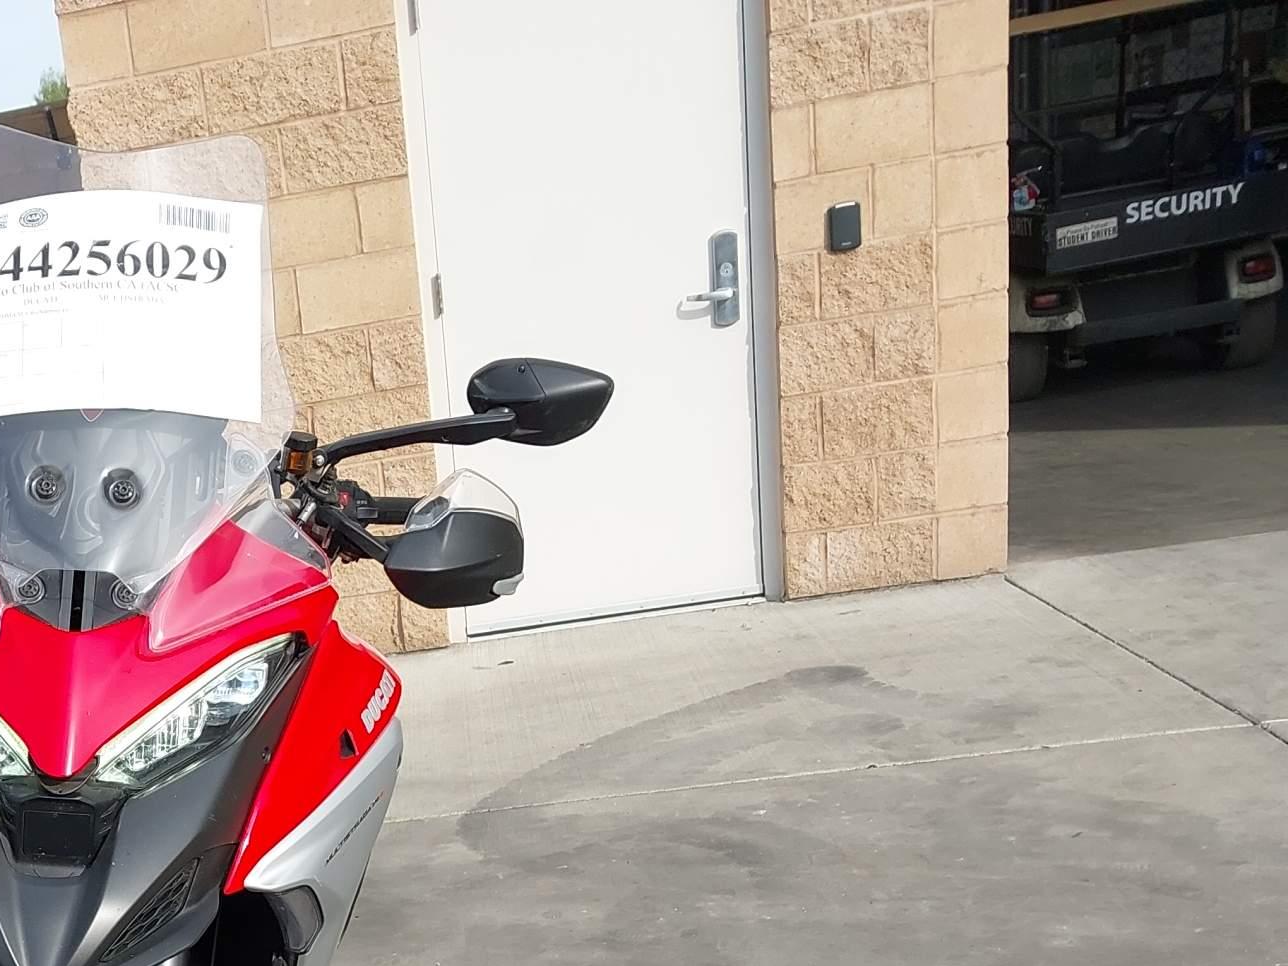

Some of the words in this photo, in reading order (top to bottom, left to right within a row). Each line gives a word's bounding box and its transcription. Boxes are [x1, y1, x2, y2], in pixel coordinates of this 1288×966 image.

[1125, 182, 1246, 225] SECURITY
[1058, 231, 1089, 247] STUDENT
[1091, 225, 1117, 241] DRIVER
[0, 239, 228, 284] 44256029
[12, 282, 41, 296] Club
[43, 281, 55, 292] of
[60, 279, 113, 291] Southern
